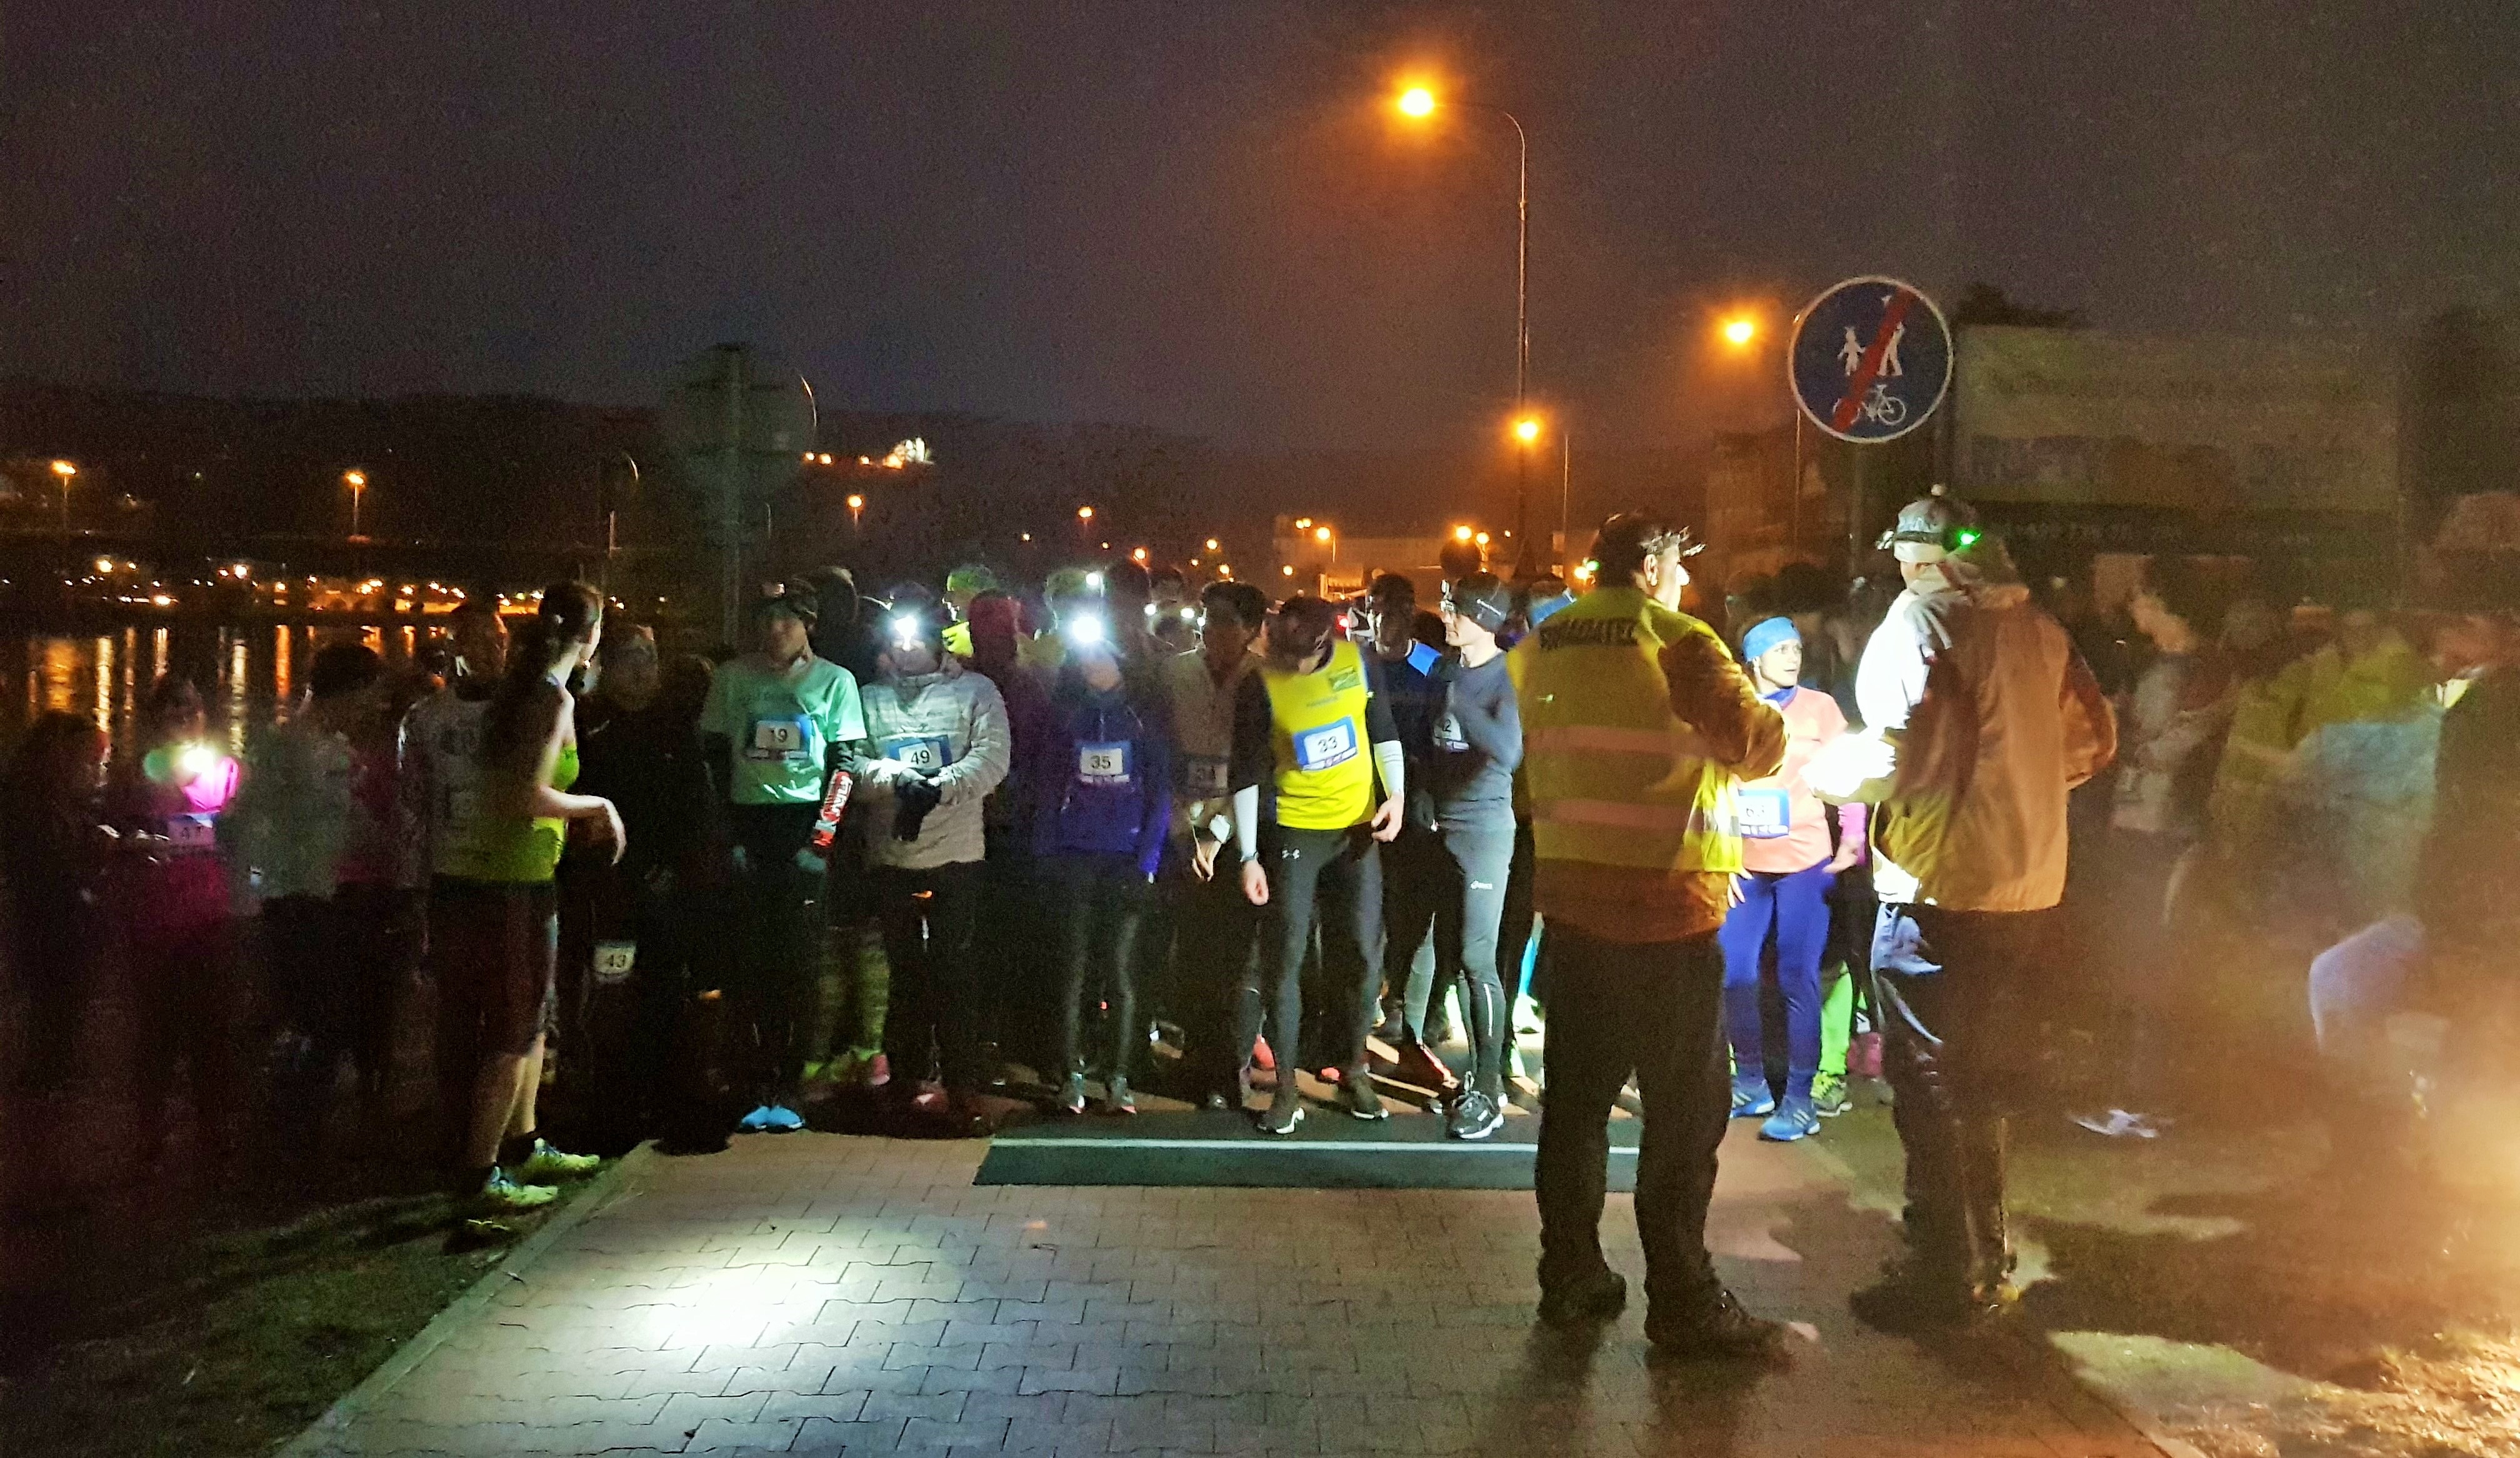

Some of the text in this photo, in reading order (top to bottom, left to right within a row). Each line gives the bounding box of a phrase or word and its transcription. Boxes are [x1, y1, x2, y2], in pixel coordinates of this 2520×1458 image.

[769, 728, 788, 743] 19
[1318, 736, 1338, 753] 33
[911, 750, 930, 765] 49
[1091, 755, 1111, 770] 35
[606, 955, 626, 968] 43
